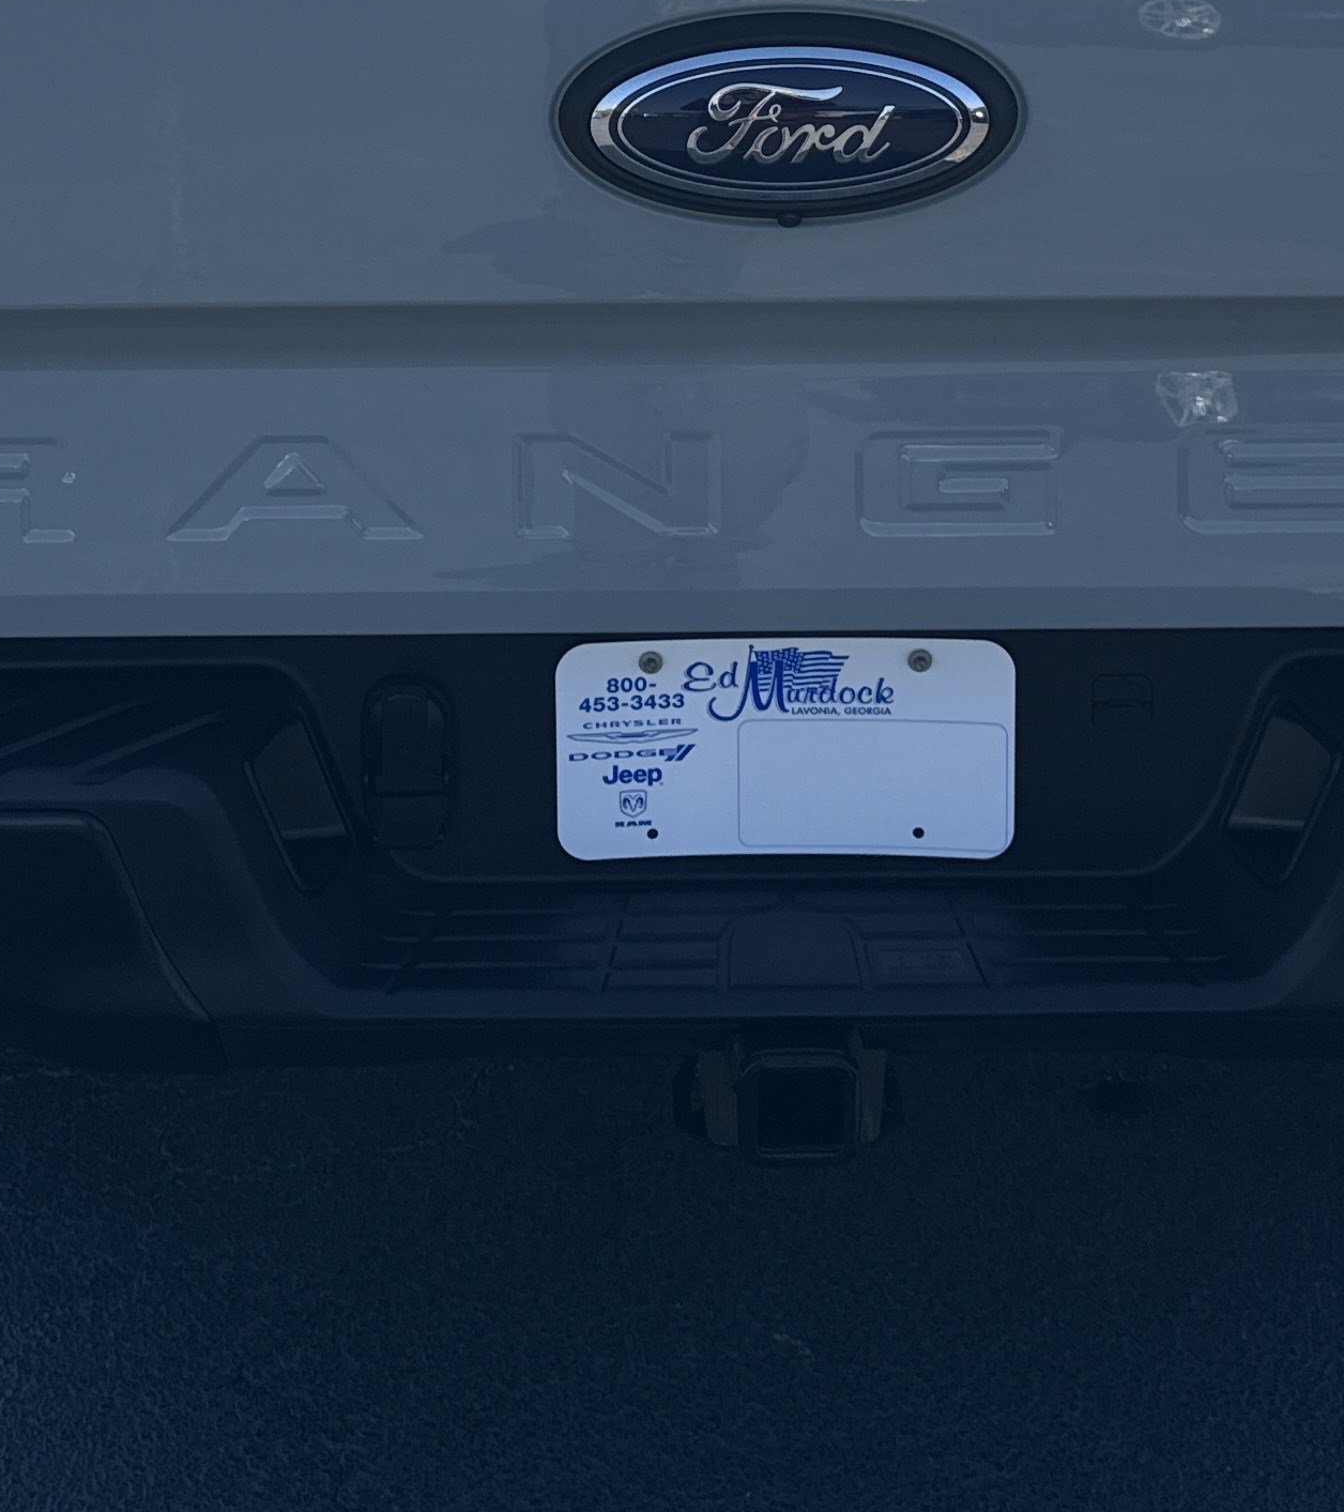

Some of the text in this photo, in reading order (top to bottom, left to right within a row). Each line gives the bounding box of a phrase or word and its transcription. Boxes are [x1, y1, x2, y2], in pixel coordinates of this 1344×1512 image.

[686, 82, 896, 165] Ford
[606, 676, 657, 694] 800-
[683, 645, 895, 722] Ed Murdock
[579, 693, 685, 713] 453-3433
[844, 706, 892, 716] GEORGIA
[582, 718, 683, 730] CHRYSLER
[602, 764, 663, 786] Jeep
